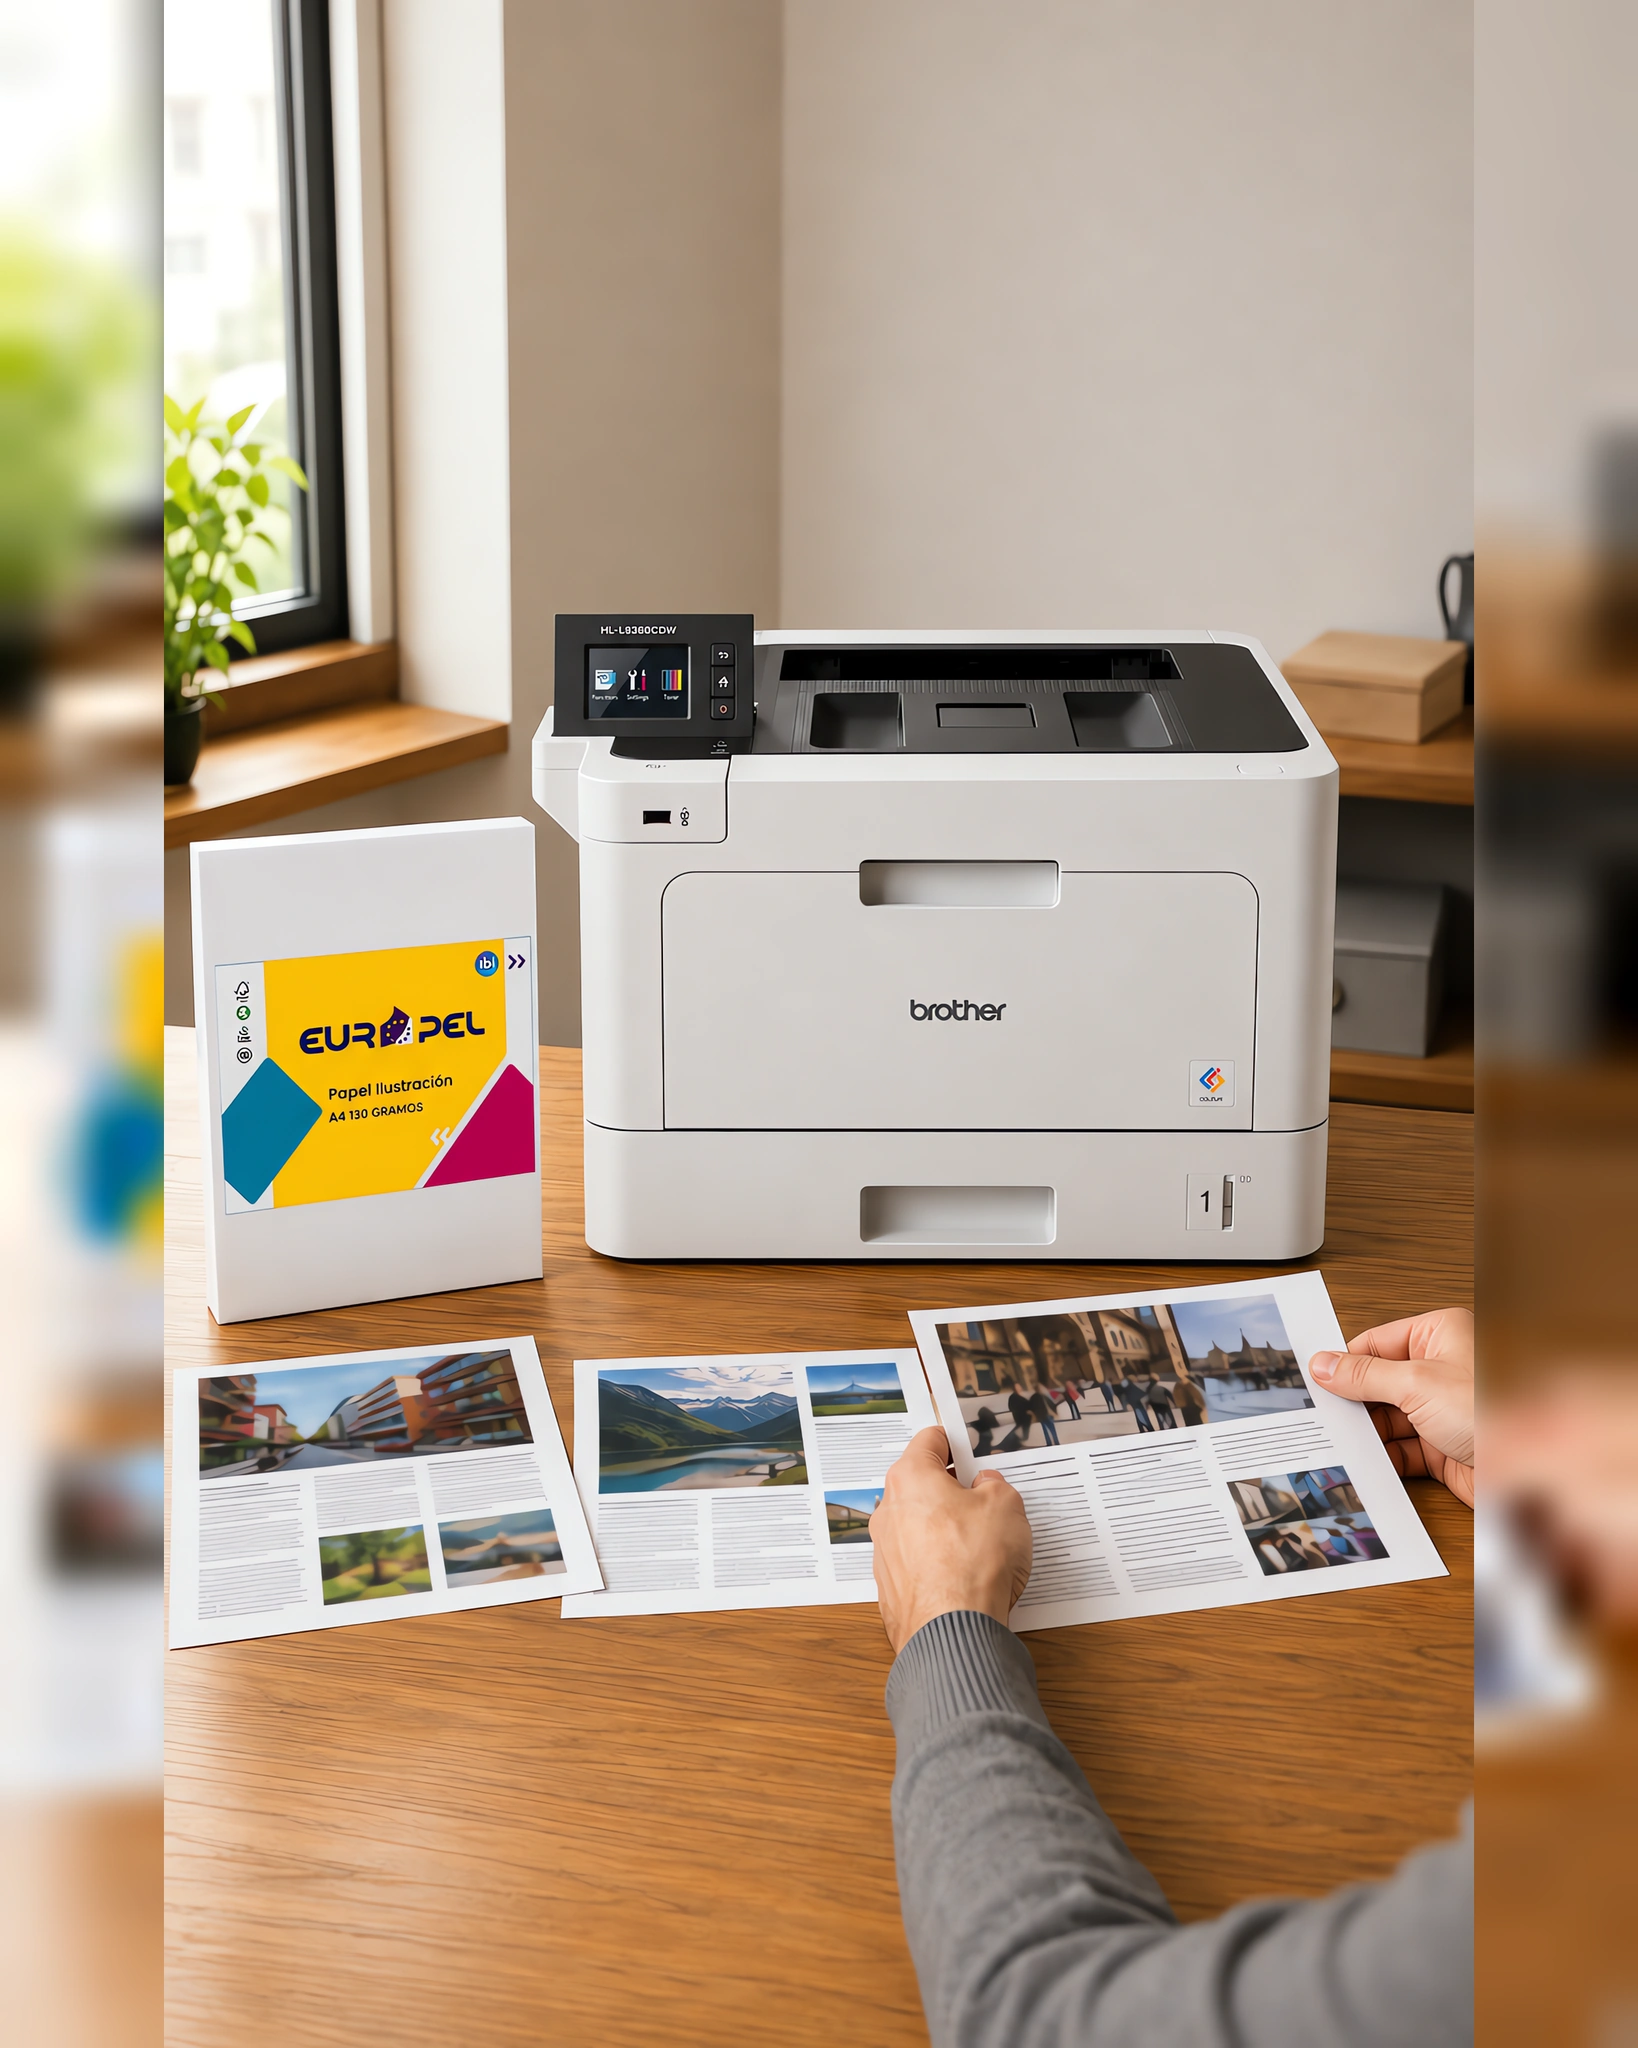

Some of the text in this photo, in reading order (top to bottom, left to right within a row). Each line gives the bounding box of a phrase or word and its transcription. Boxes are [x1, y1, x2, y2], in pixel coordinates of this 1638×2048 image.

[909, 999, 1007, 1021] brother
[299, 1006, 486, 1055] EURPEL
[328, 1074, 453, 1102] Papel Ilustración
[328, 1102, 424, 1123] A4 130 GRAMOS
[1200, 1190, 1210, 1213] 1
